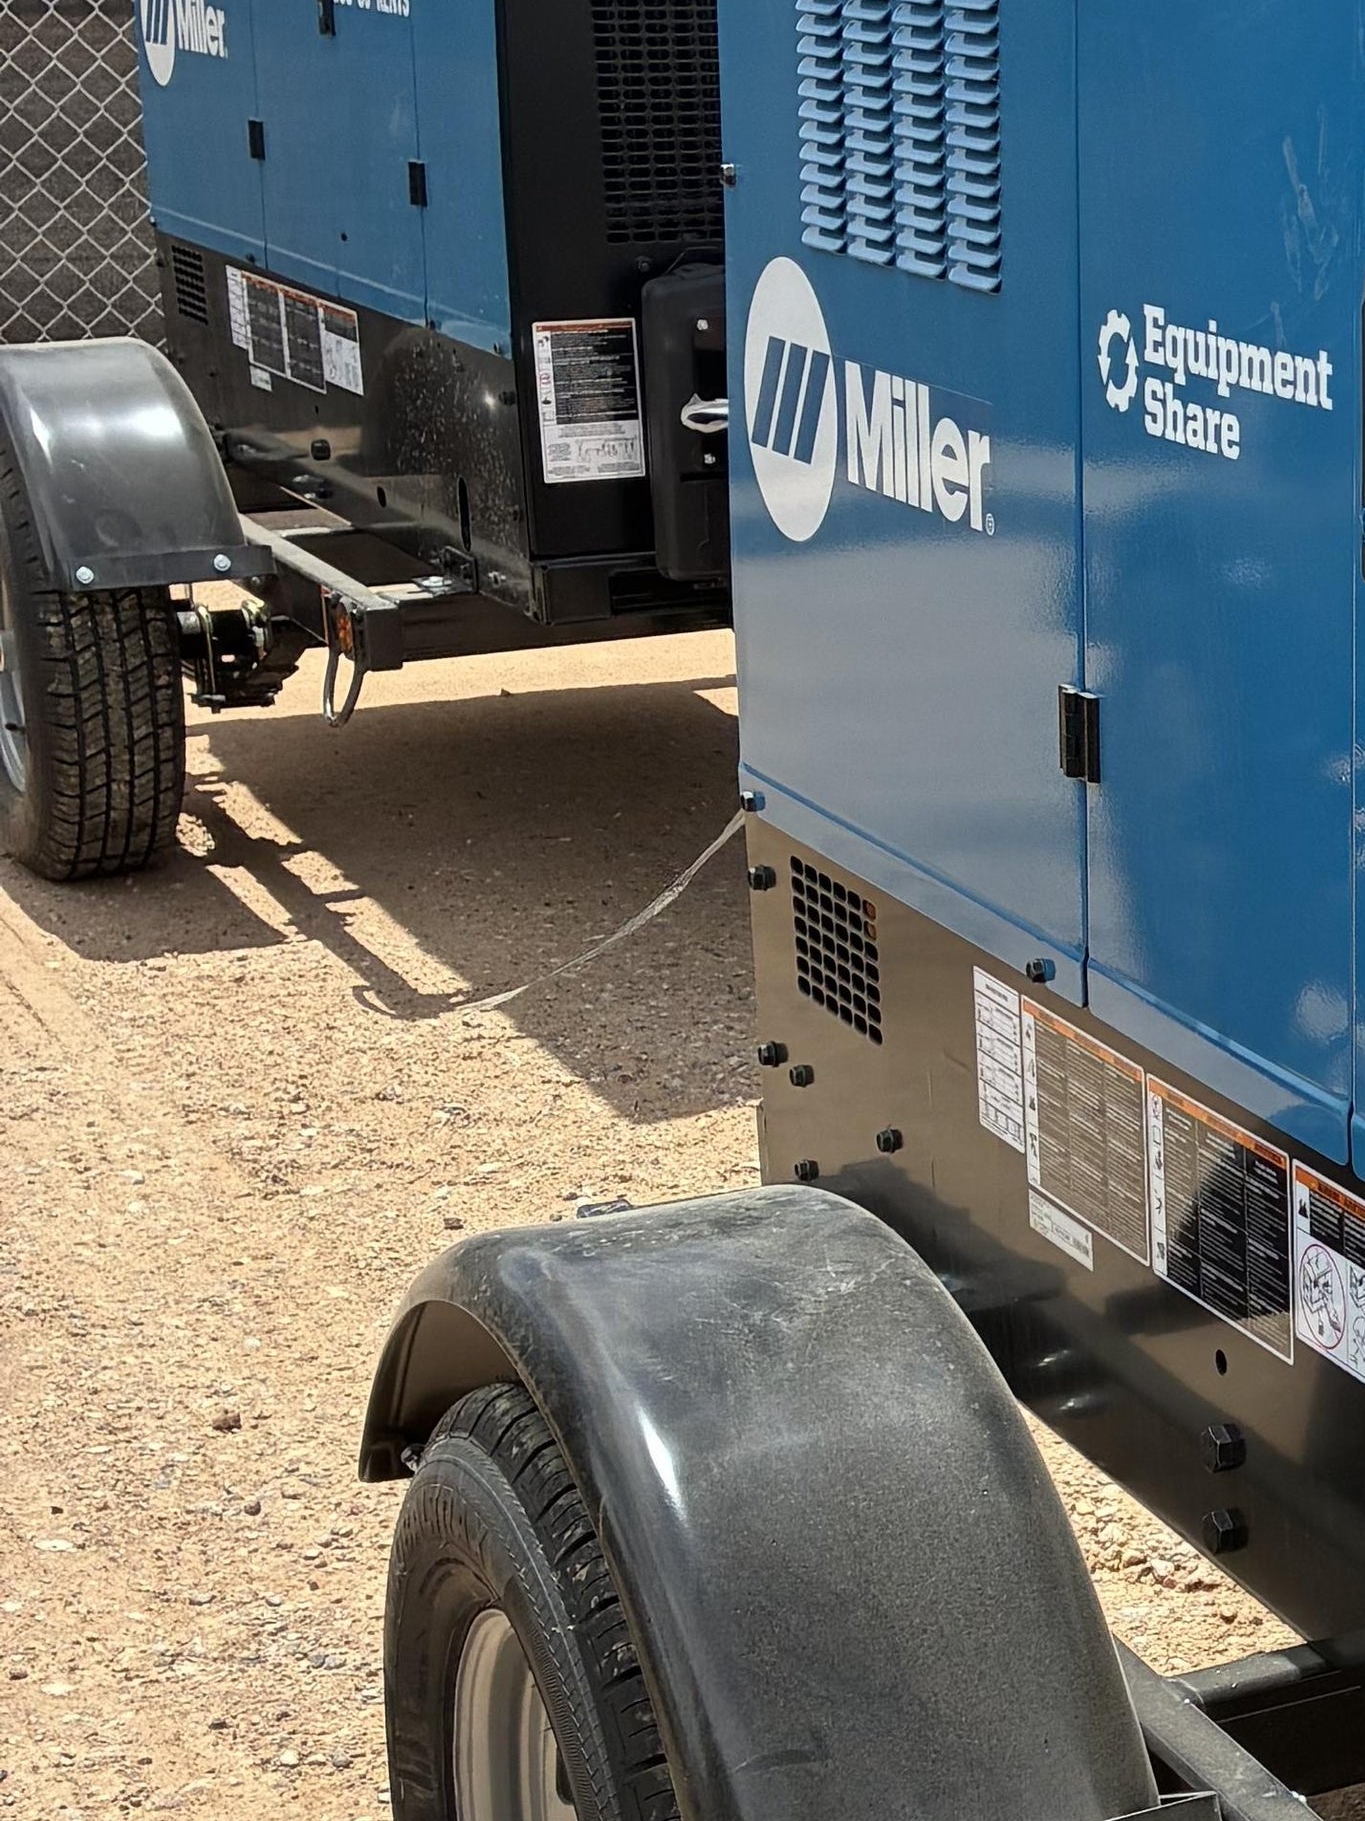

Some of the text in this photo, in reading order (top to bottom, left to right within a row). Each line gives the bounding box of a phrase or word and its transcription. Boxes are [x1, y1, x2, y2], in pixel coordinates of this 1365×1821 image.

[1143, 303, 1334, 411] Equipment
[845, 359, 991, 533] Miller
[1144, 378, 1241, 460] Share
